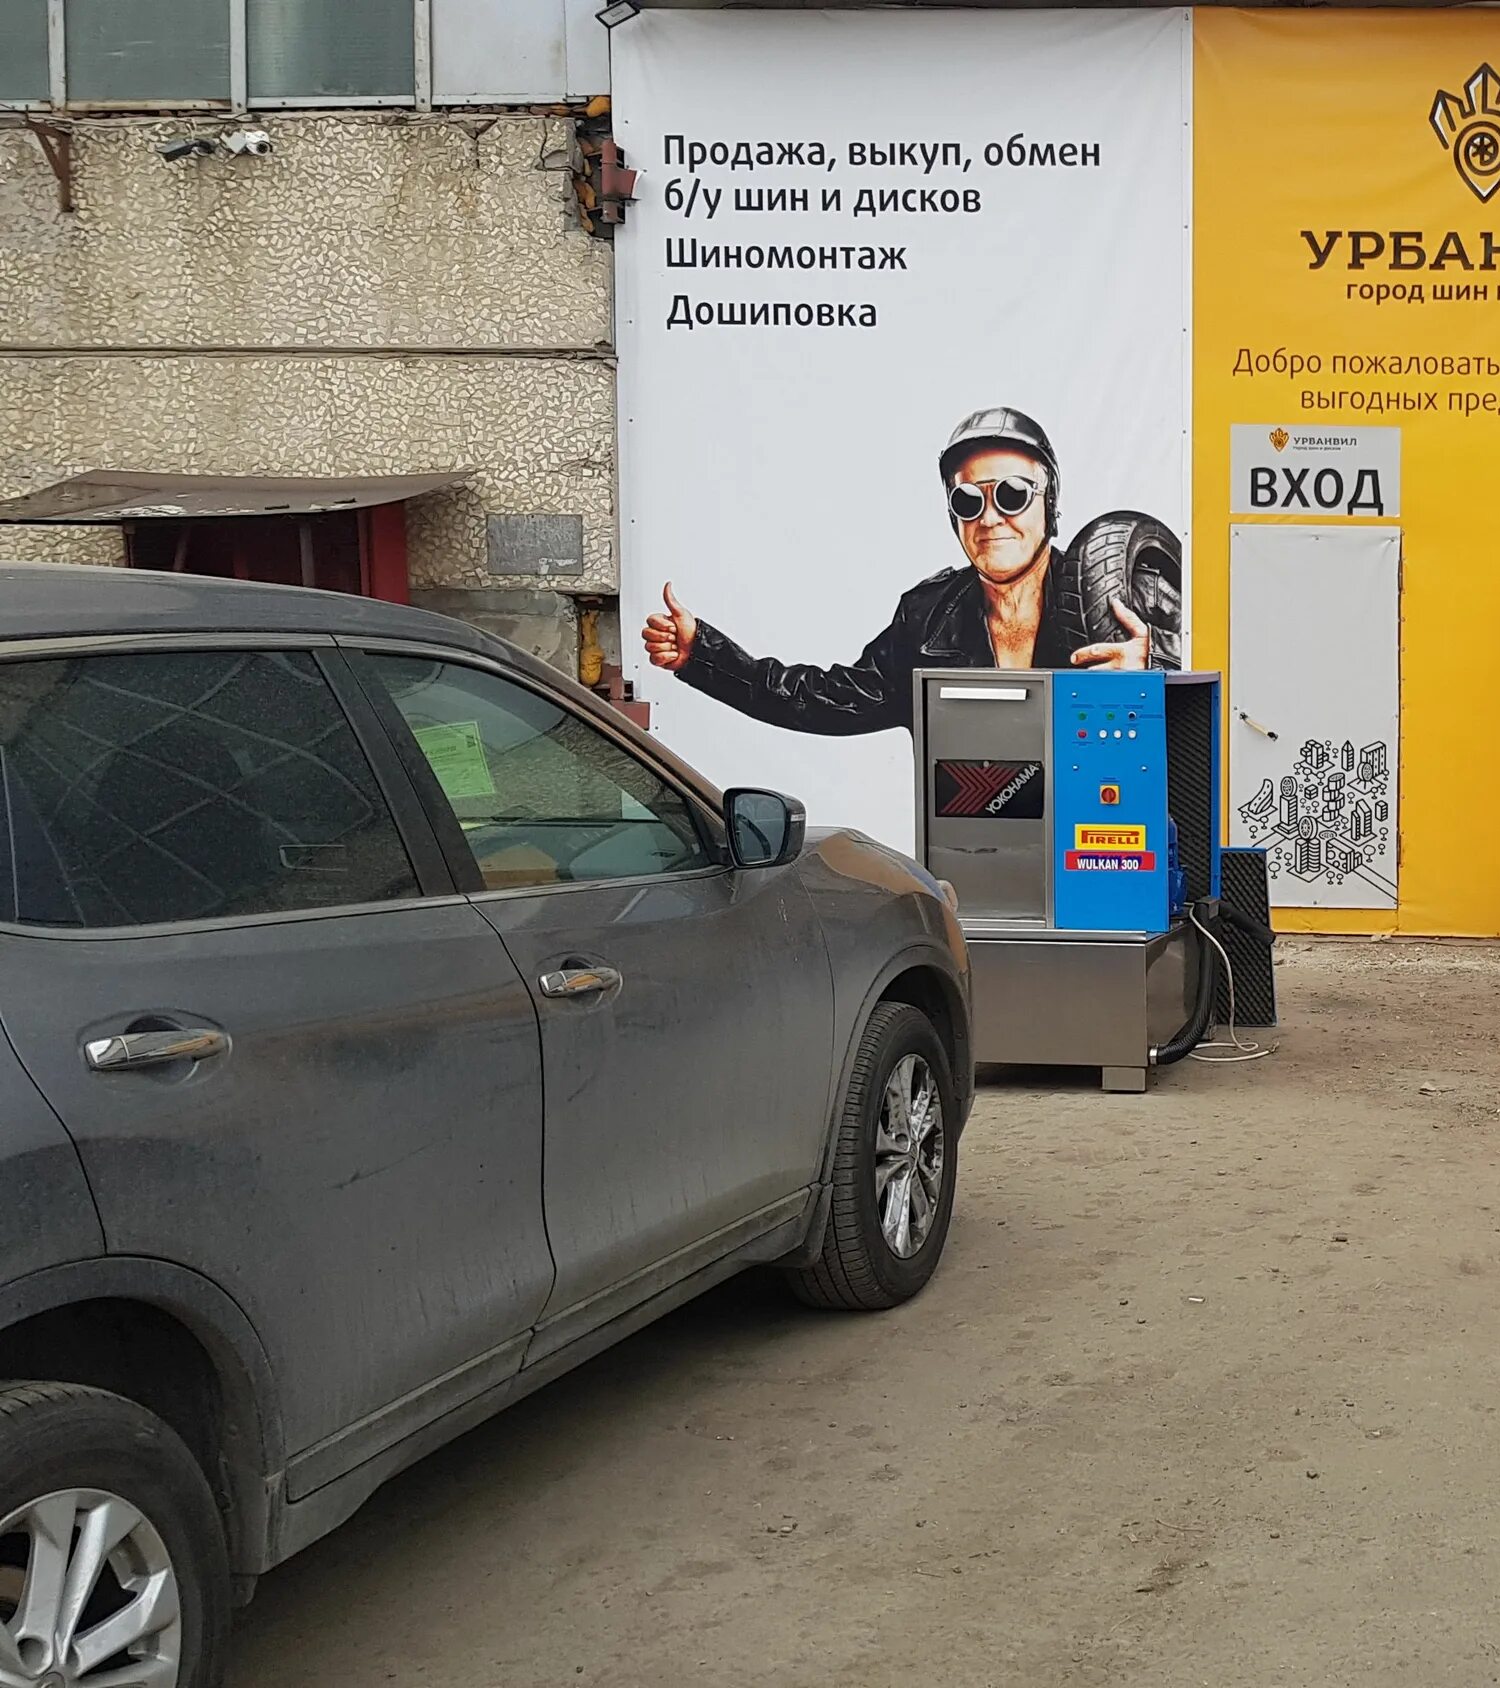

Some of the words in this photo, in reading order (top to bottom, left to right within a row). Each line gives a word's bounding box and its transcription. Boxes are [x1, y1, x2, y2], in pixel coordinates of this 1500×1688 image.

[664, 134, 837, 174] Продажа,
[848, 142, 972, 174] выкуп,
[983, 132, 1100, 167] обмен
[664, 177, 723, 220] б/у
[734, 188, 809, 212] шин
[821, 188, 841, 212] и
[853, 188, 982, 218] дисков
[666, 237, 908, 270] Шиномонтаж
[1346, 283, 1425, 306] город
[1432, 284, 1488, 301] шин
[666, 294, 877, 331] Дошиповка
[1232, 347, 1322, 380] Добро
[1332, 355, 1500, 377] пожаловать
[1300, 388, 1438, 415] выгодных
[1250, 466, 1384, 517] ВХОД
[984, 763, 1040, 815] YOKOHAMA
[1080, 829, 1140, 845] PIRELLI
[1076, 858, 1119, 870] WULKAN
[1121, 858, 1139, 870] 300
